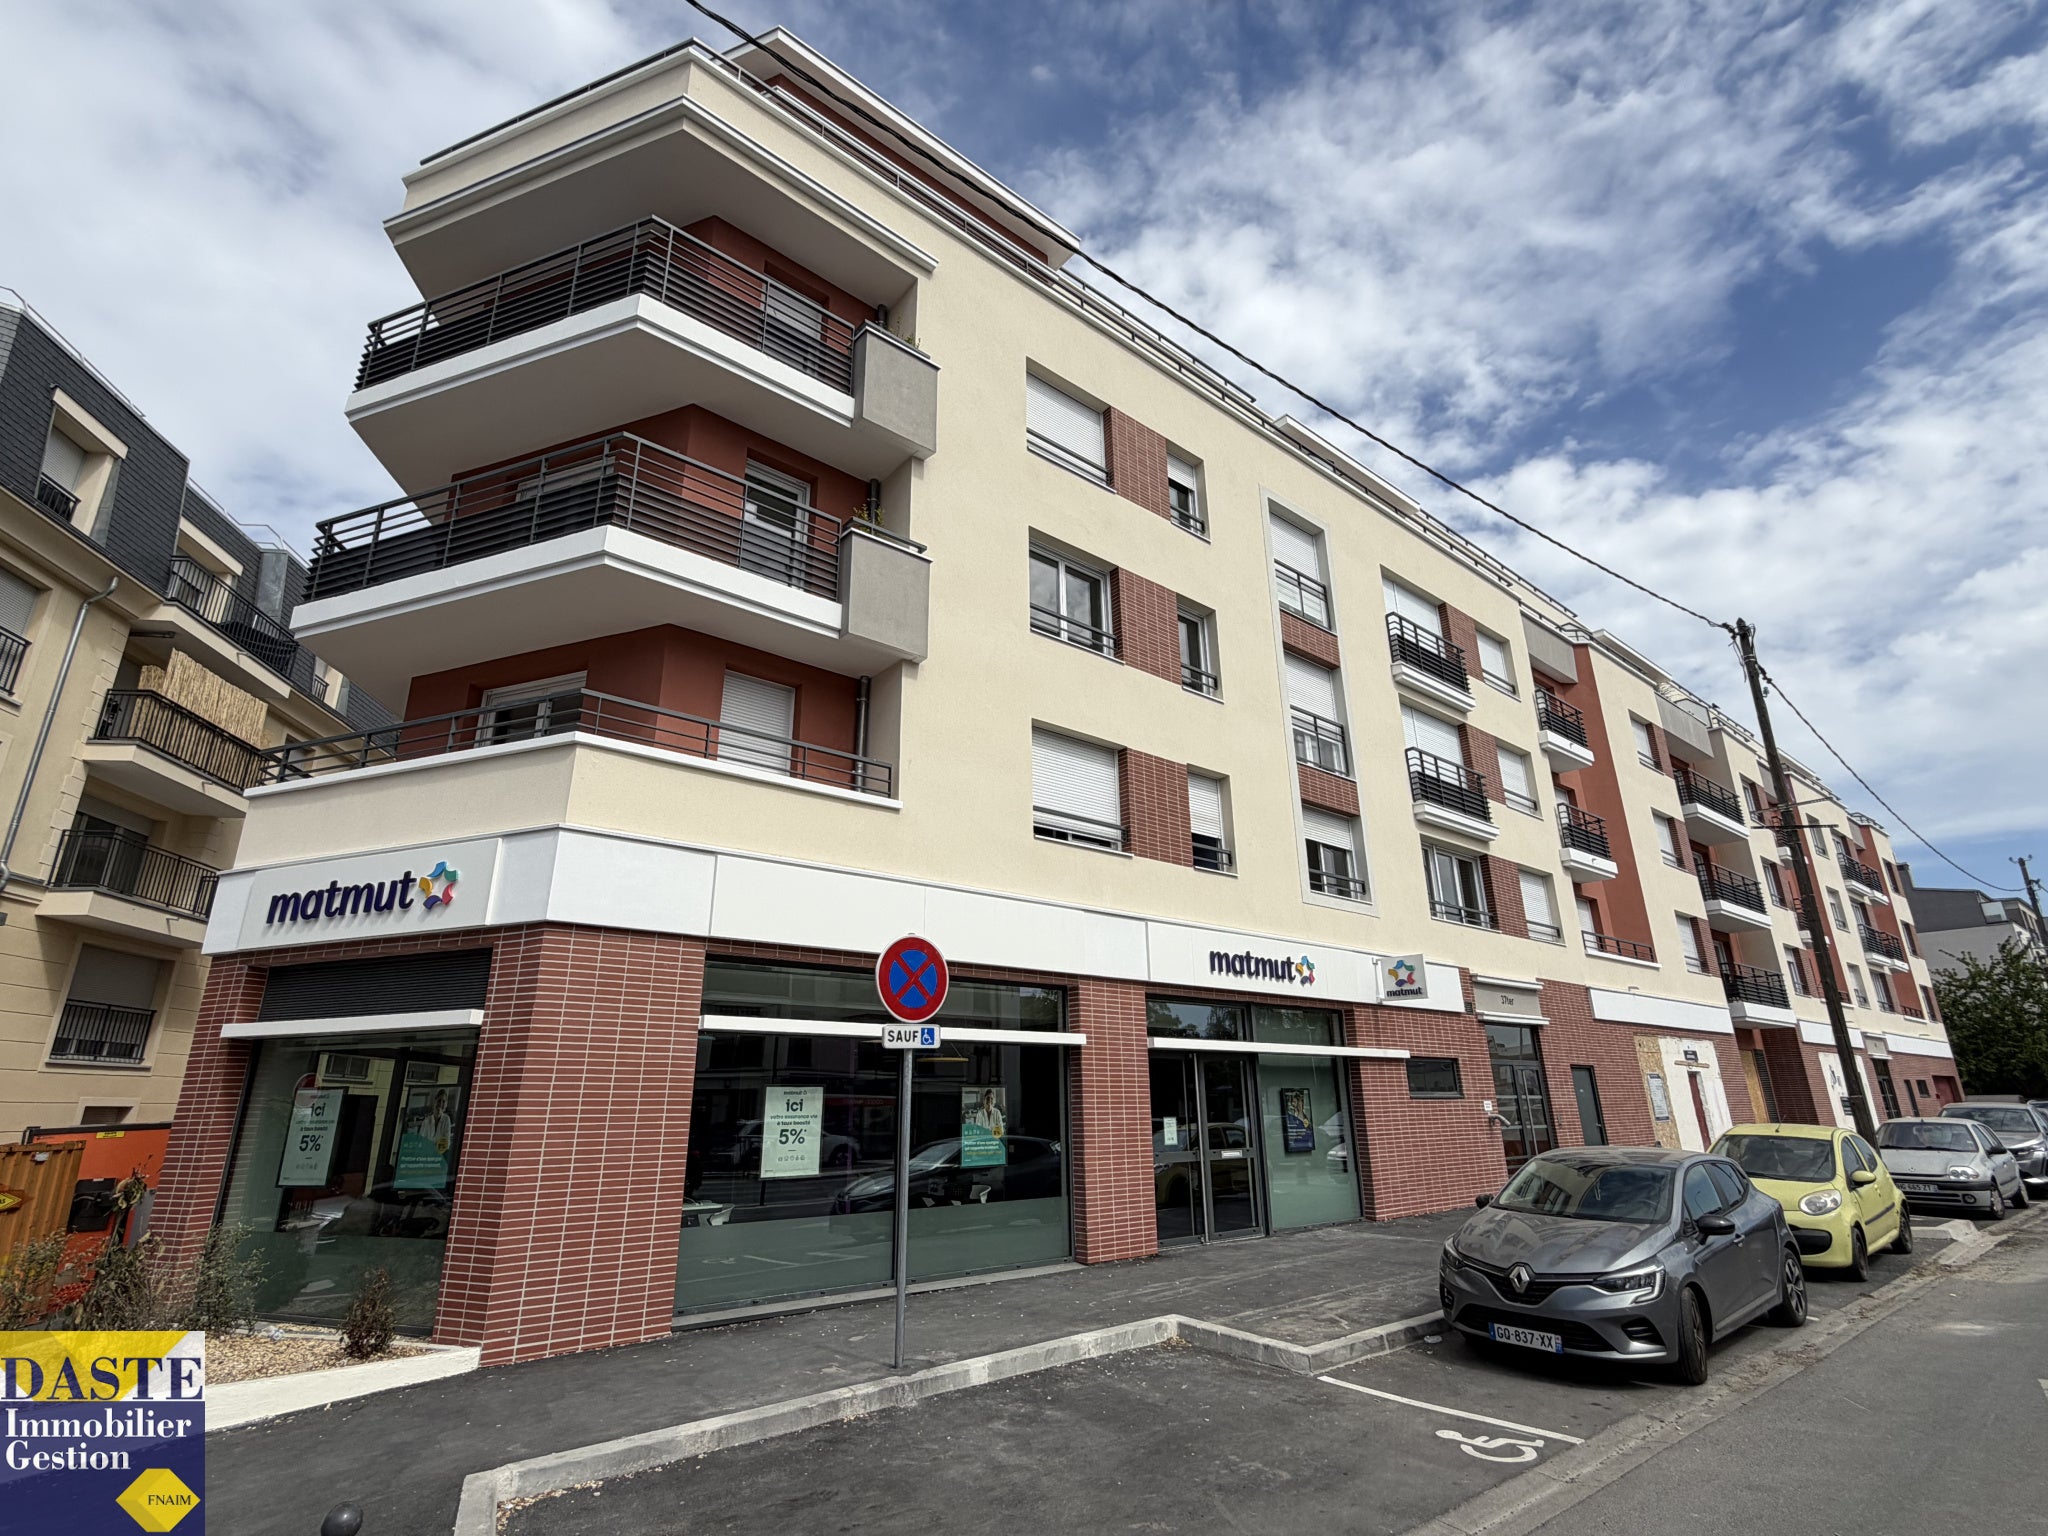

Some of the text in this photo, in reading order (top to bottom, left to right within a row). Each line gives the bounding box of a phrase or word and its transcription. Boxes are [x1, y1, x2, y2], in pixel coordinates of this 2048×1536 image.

[266, 871, 417, 924] matmut
[1209, 950, 1296, 981] matmut
[1386, 986, 1422, 998] matmut
[887, 1030, 919, 1043] SAUF
[310, 1102, 326, 1117] ici
[786, 1099, 803, 1112] ici
[1496, 1326, 1554, 1349] GQ-837-XX
